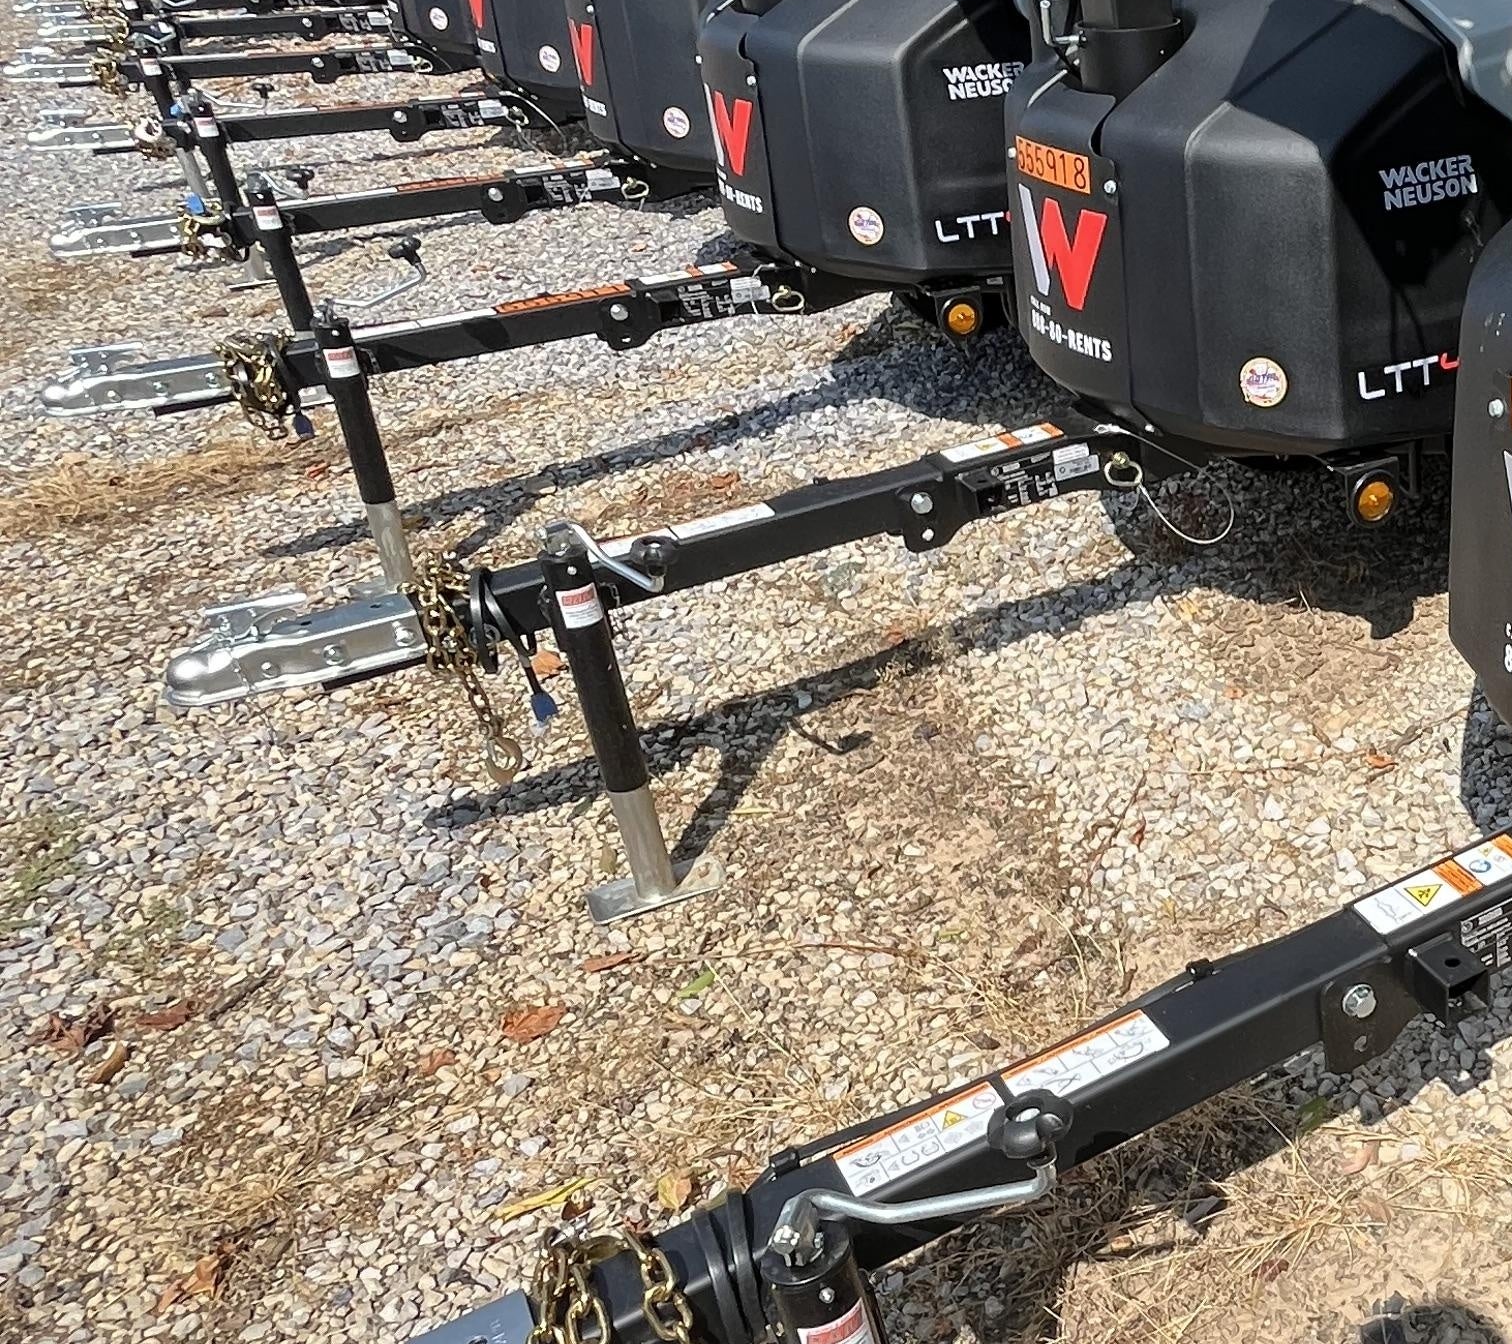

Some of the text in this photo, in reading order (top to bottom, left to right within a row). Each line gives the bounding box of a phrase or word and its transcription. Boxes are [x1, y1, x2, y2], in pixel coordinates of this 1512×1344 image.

[943, 61, 1024, 84] WACKER
[948, 77, 1013, 101] NEUSO
[1017, 140, 1087, 190] 555918
[1379, 155, 1475, 189] WACKER
[1384, 174, 1478, 211] NEUSON
[935, 211, 1011, 243] LTT
